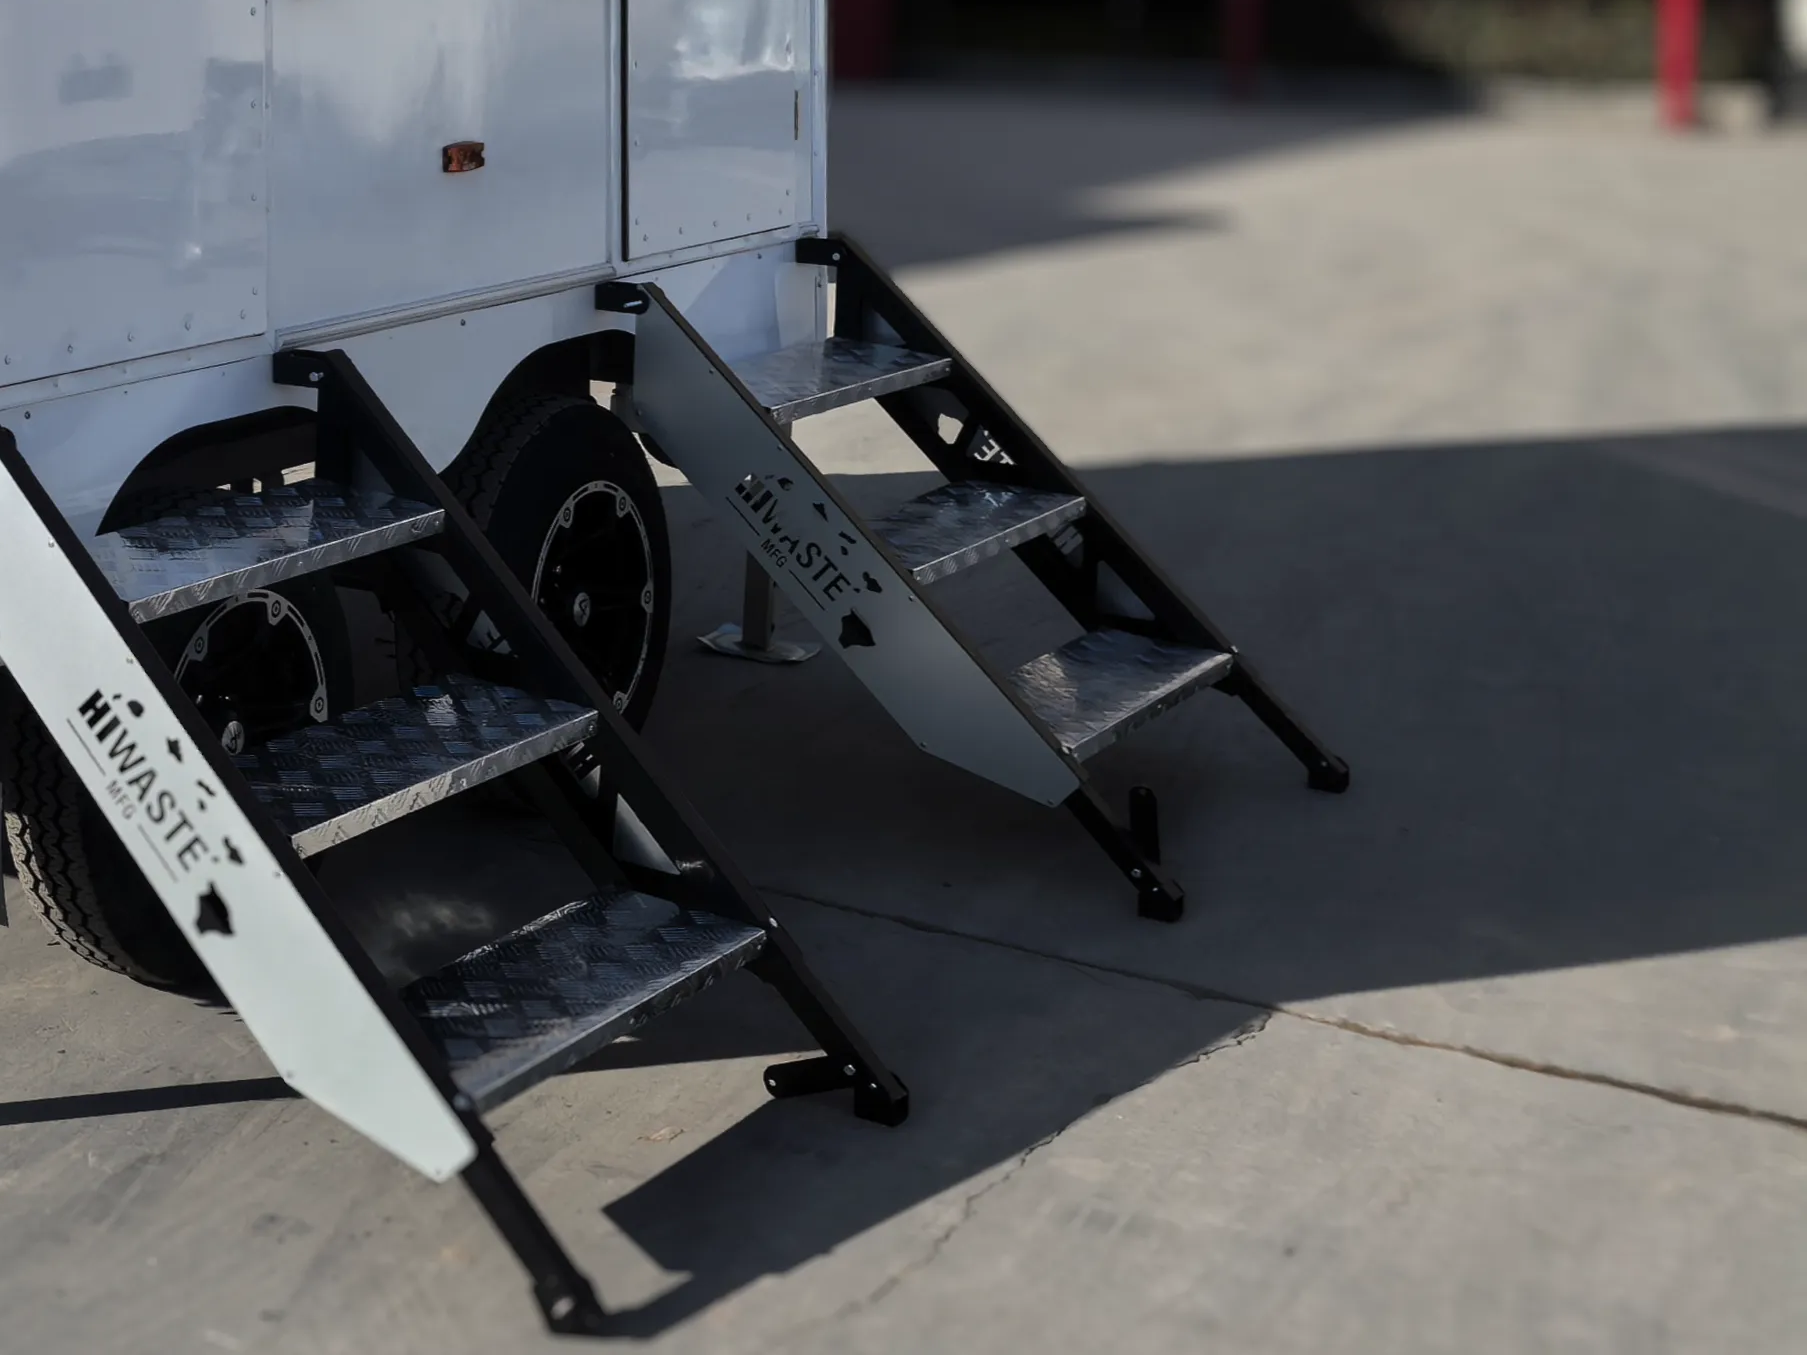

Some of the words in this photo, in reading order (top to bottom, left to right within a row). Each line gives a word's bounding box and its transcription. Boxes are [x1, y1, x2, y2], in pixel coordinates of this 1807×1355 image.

[760, 538, 789, 569] MFG
[77, 687, 210, 874] HIWASTE
[105, 779, 138, 821] MFG
